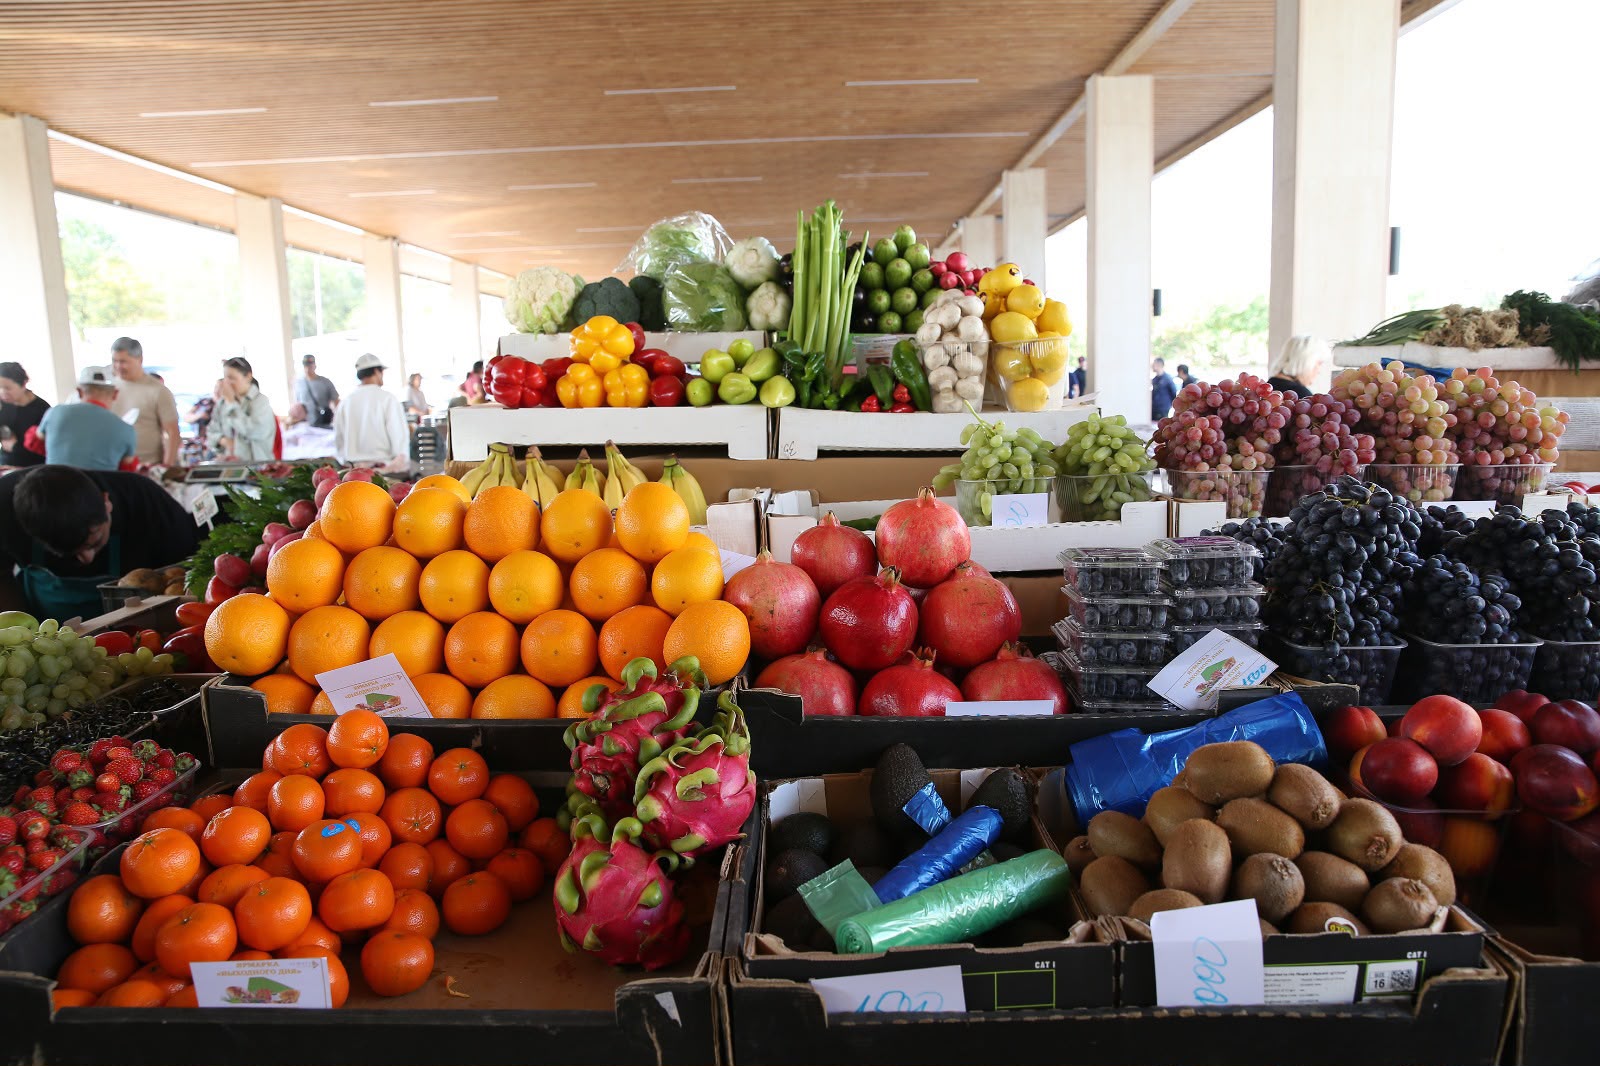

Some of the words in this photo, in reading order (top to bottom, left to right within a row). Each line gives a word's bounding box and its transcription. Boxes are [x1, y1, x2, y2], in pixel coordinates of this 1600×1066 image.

[1406, 950, 1422, 959] CAT
[1034, 960, 1050, 969] CAT
[1374, 979, 1385, 989] 16
